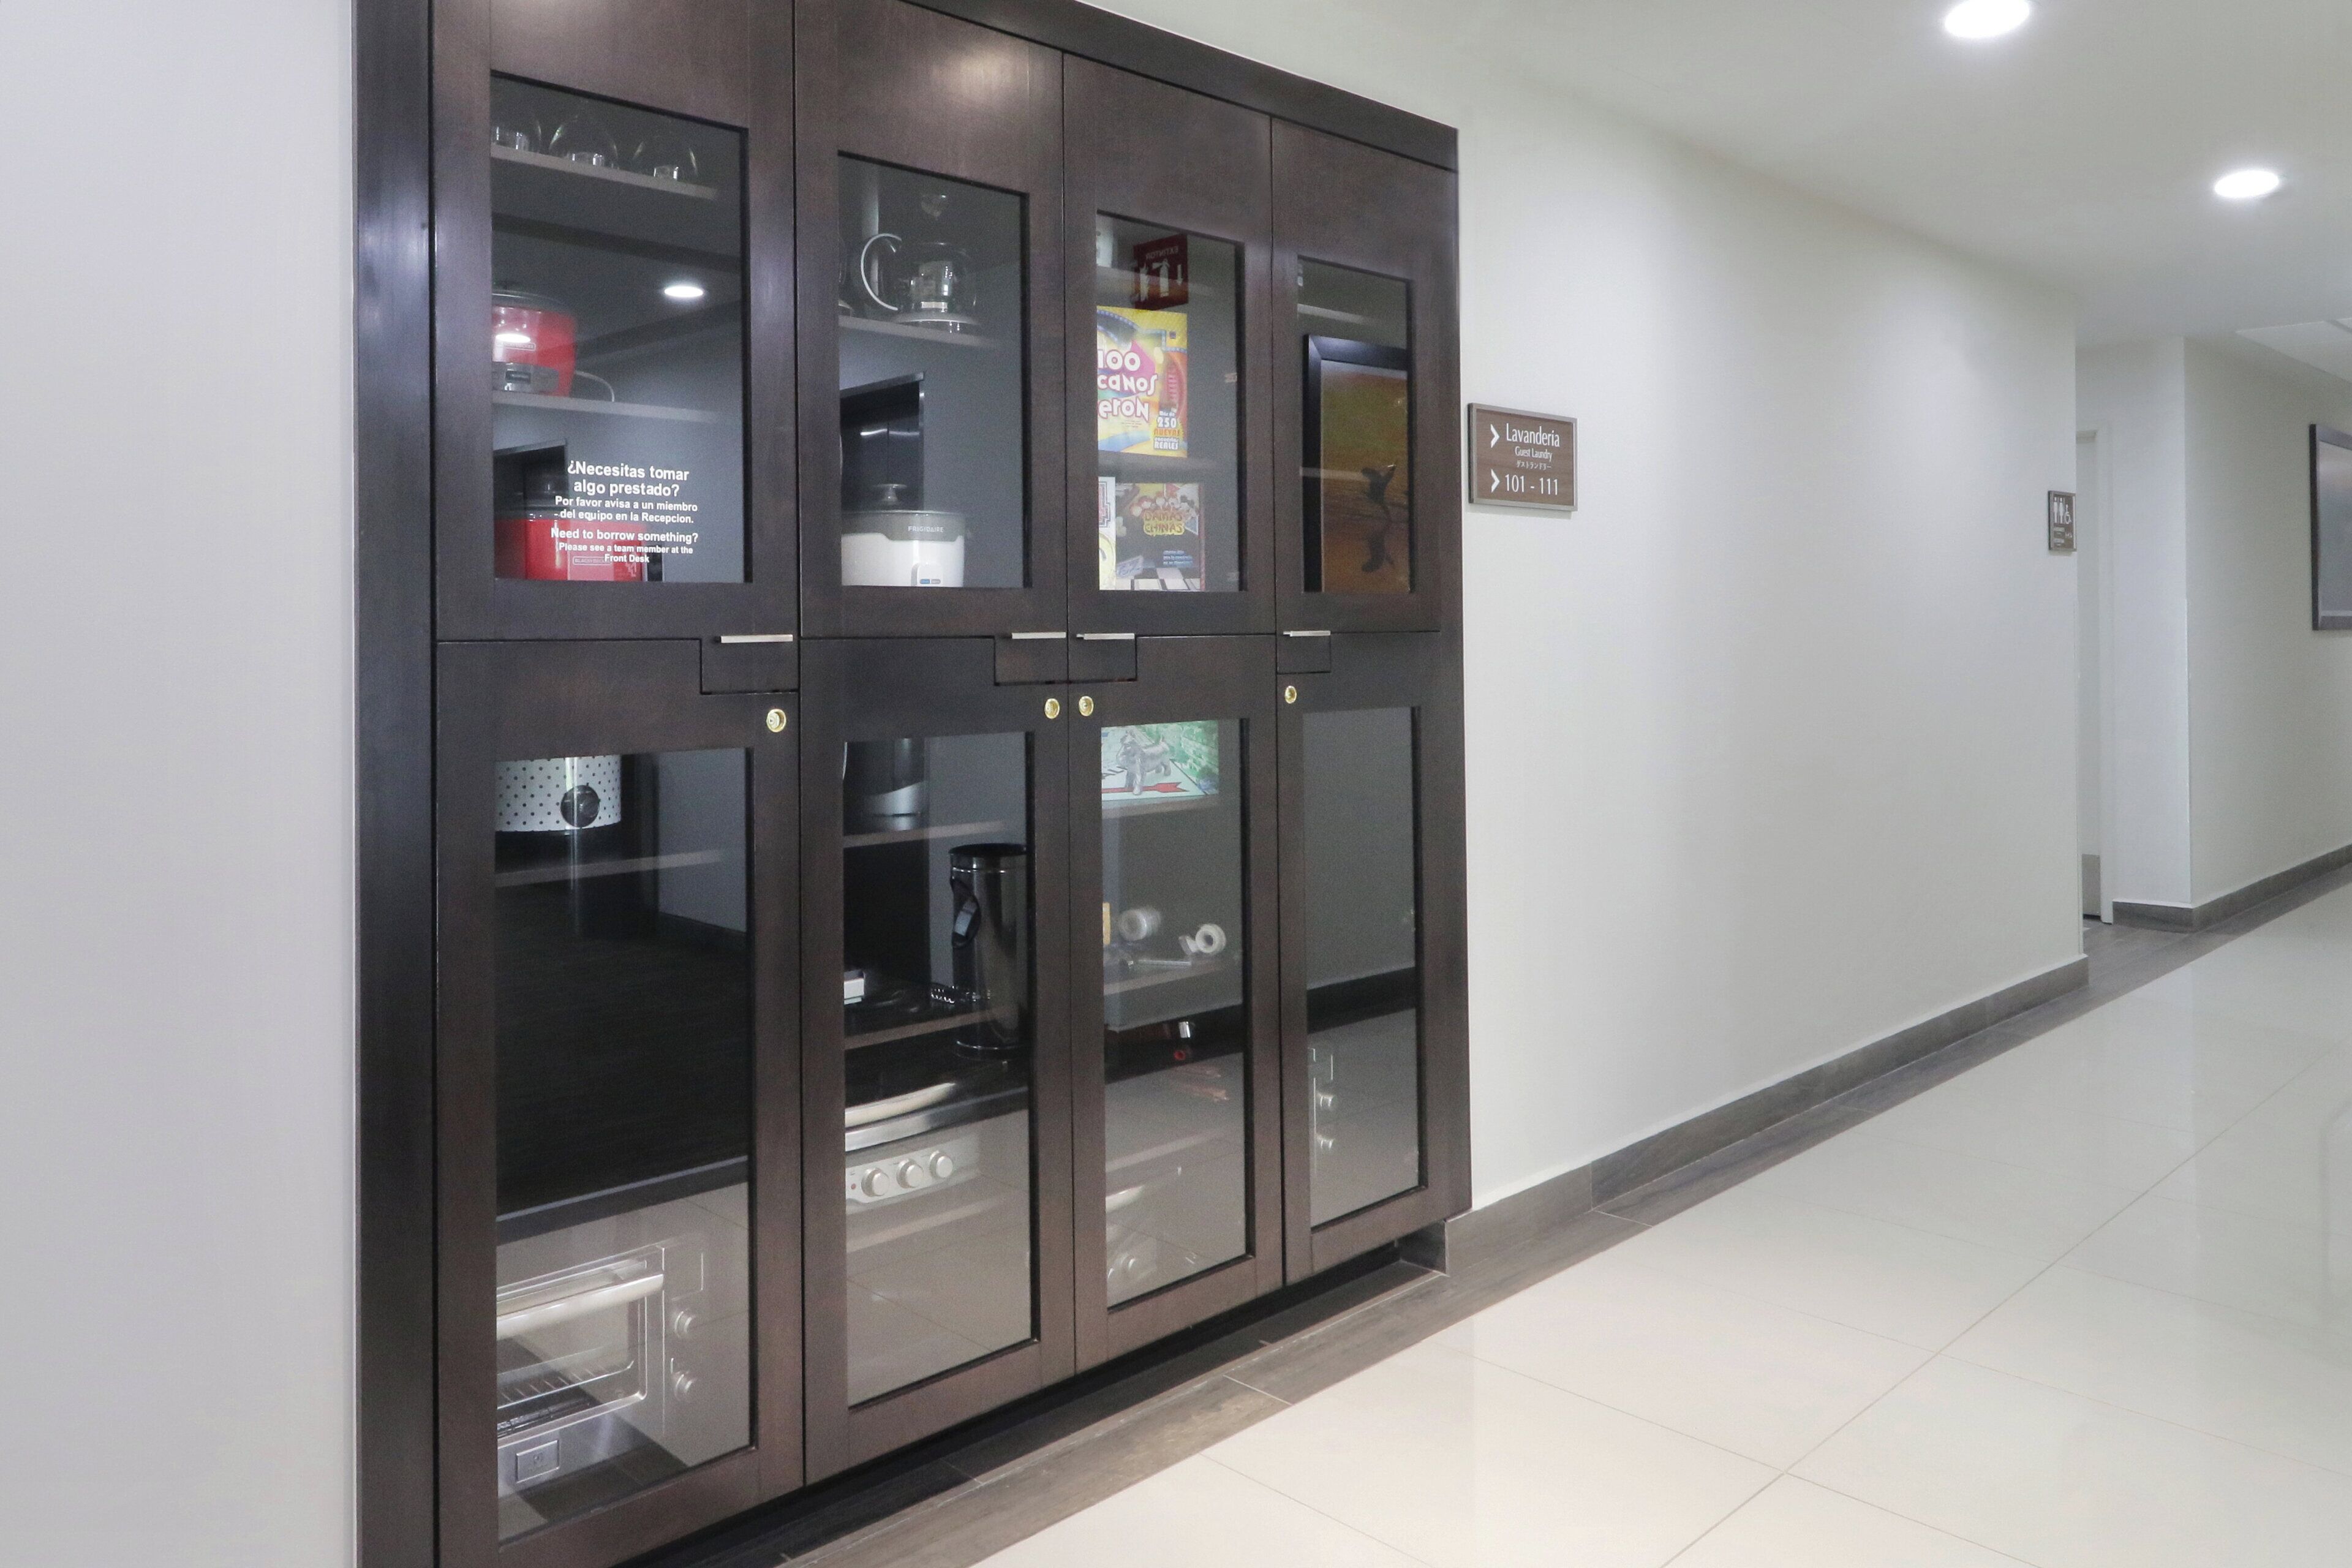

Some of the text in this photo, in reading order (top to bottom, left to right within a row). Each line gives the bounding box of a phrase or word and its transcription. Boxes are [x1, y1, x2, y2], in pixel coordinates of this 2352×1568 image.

[1157, 417, 1177, 428] 250
[1155, 442, 1178, 450] REALES
[1515, 446, 1553, 462] Guest Laundry
[567, 461, 690, 481] ¿Necesitas tomar
[574, 480, 680, 497] algo prestado?
[1505, 474, 1525, 492] 101
[1539, 477, 1558, 496] 111
[555, 496, 574, 506] Por
[576, 497, 602, 507] favor
[605, 499, 630, 508] avisa
[657, 501, 698, 511] miembro
[560, 509, 576, 519] del
[578, 510, 613, 521] equipo
[630, 511, 639, 521] la
[641, 513, 694, 525] Recepcion.
[551, 527, 698, 544] Need to borrow something?
[1145, 523, 1183, 533] CHINAS
[559, 543, 587, 551] Please
[636, 545, 669, 554] member
[605, 554, 650, 564] Front Desk
